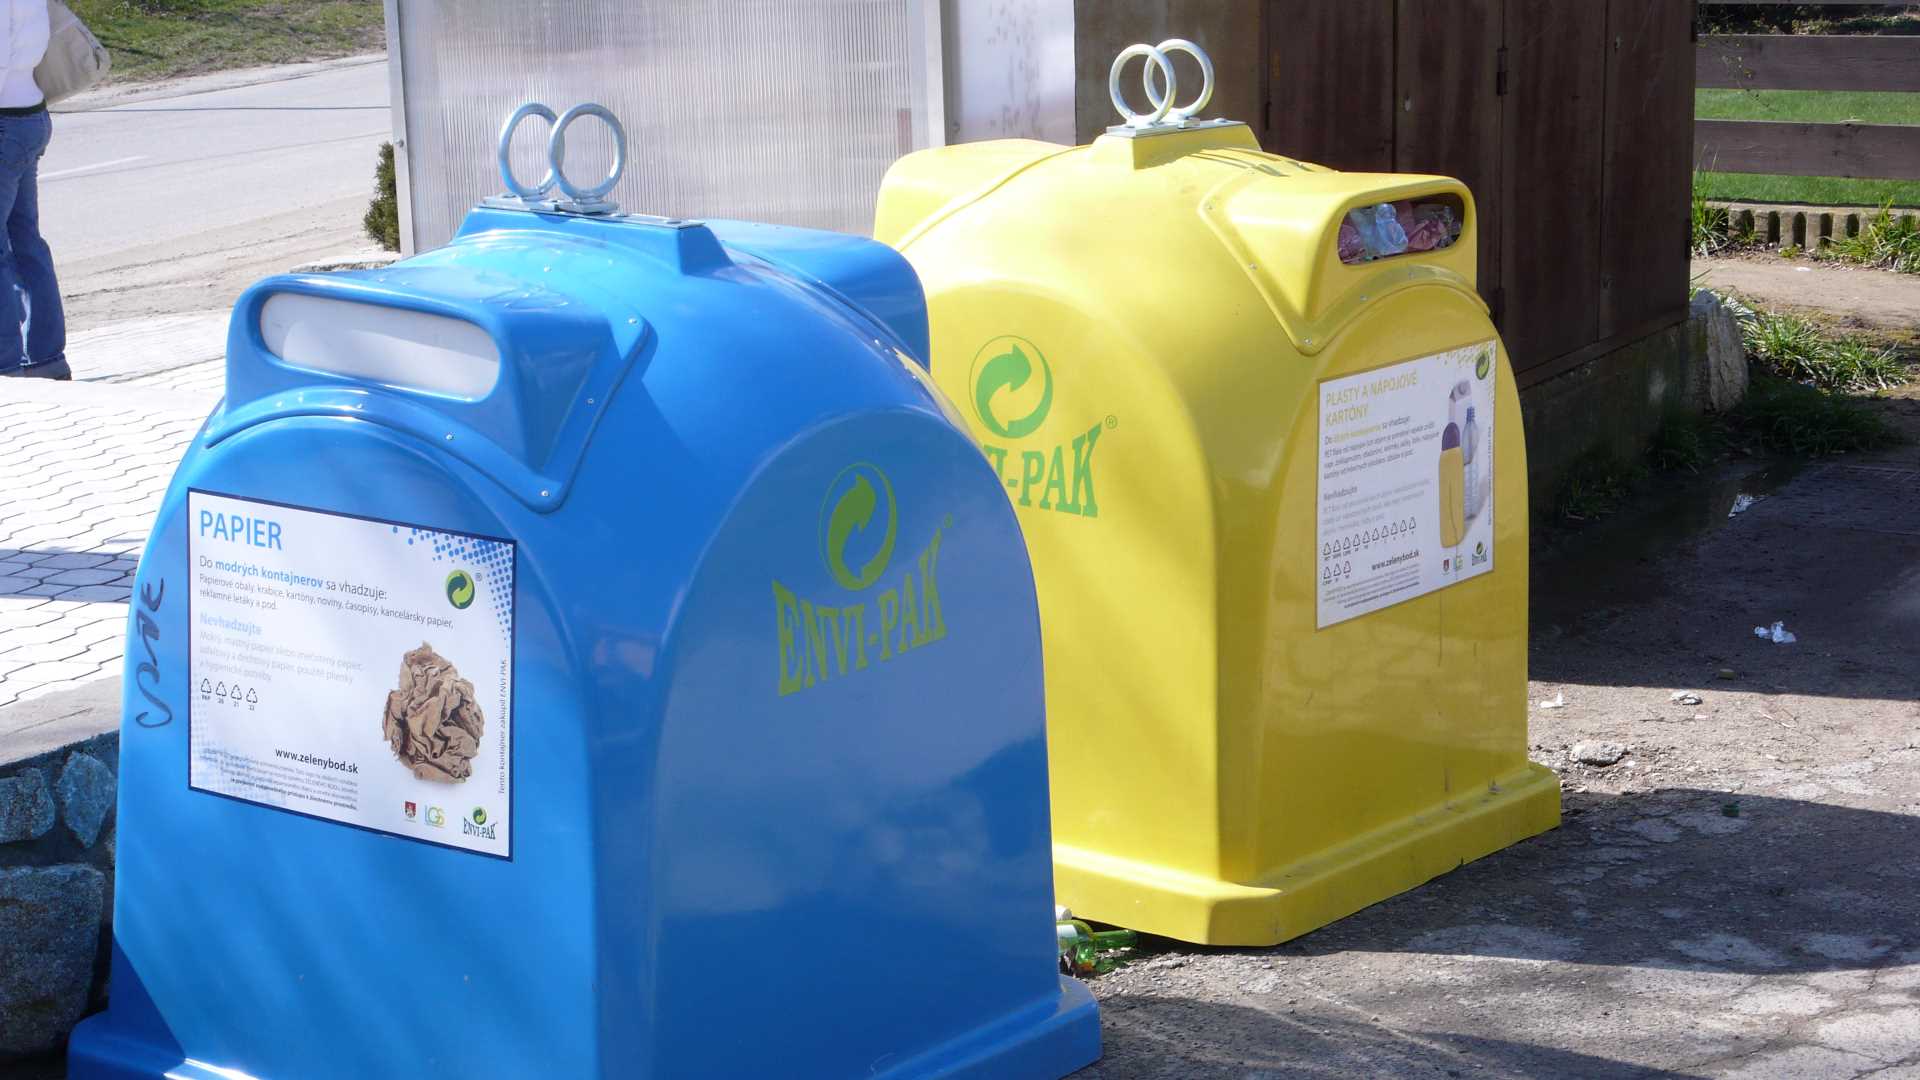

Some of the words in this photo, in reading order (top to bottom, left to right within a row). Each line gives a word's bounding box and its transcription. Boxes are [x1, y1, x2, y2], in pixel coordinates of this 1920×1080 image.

[1326, 387, 1360, 407] PLASTY
[1362, 385, 1369, 398] A
[200, 510, 282, 550] PAPIER
[199, 555, 213, 569] Do
[215, 558, 259, 579] modrých
[261, 567, 323, 589] kontajnerov
[325, 580, 337, 590] sa
[339, 581, 388, 601] vhadzuje:
[427, 614, 454, 629] papier,
[772, 527, 948, 696] ENVI-PAK
[275, 748, 358, 775] www.zelenybod.sk
[463, 817, 496, 840] ENVI-PAK
